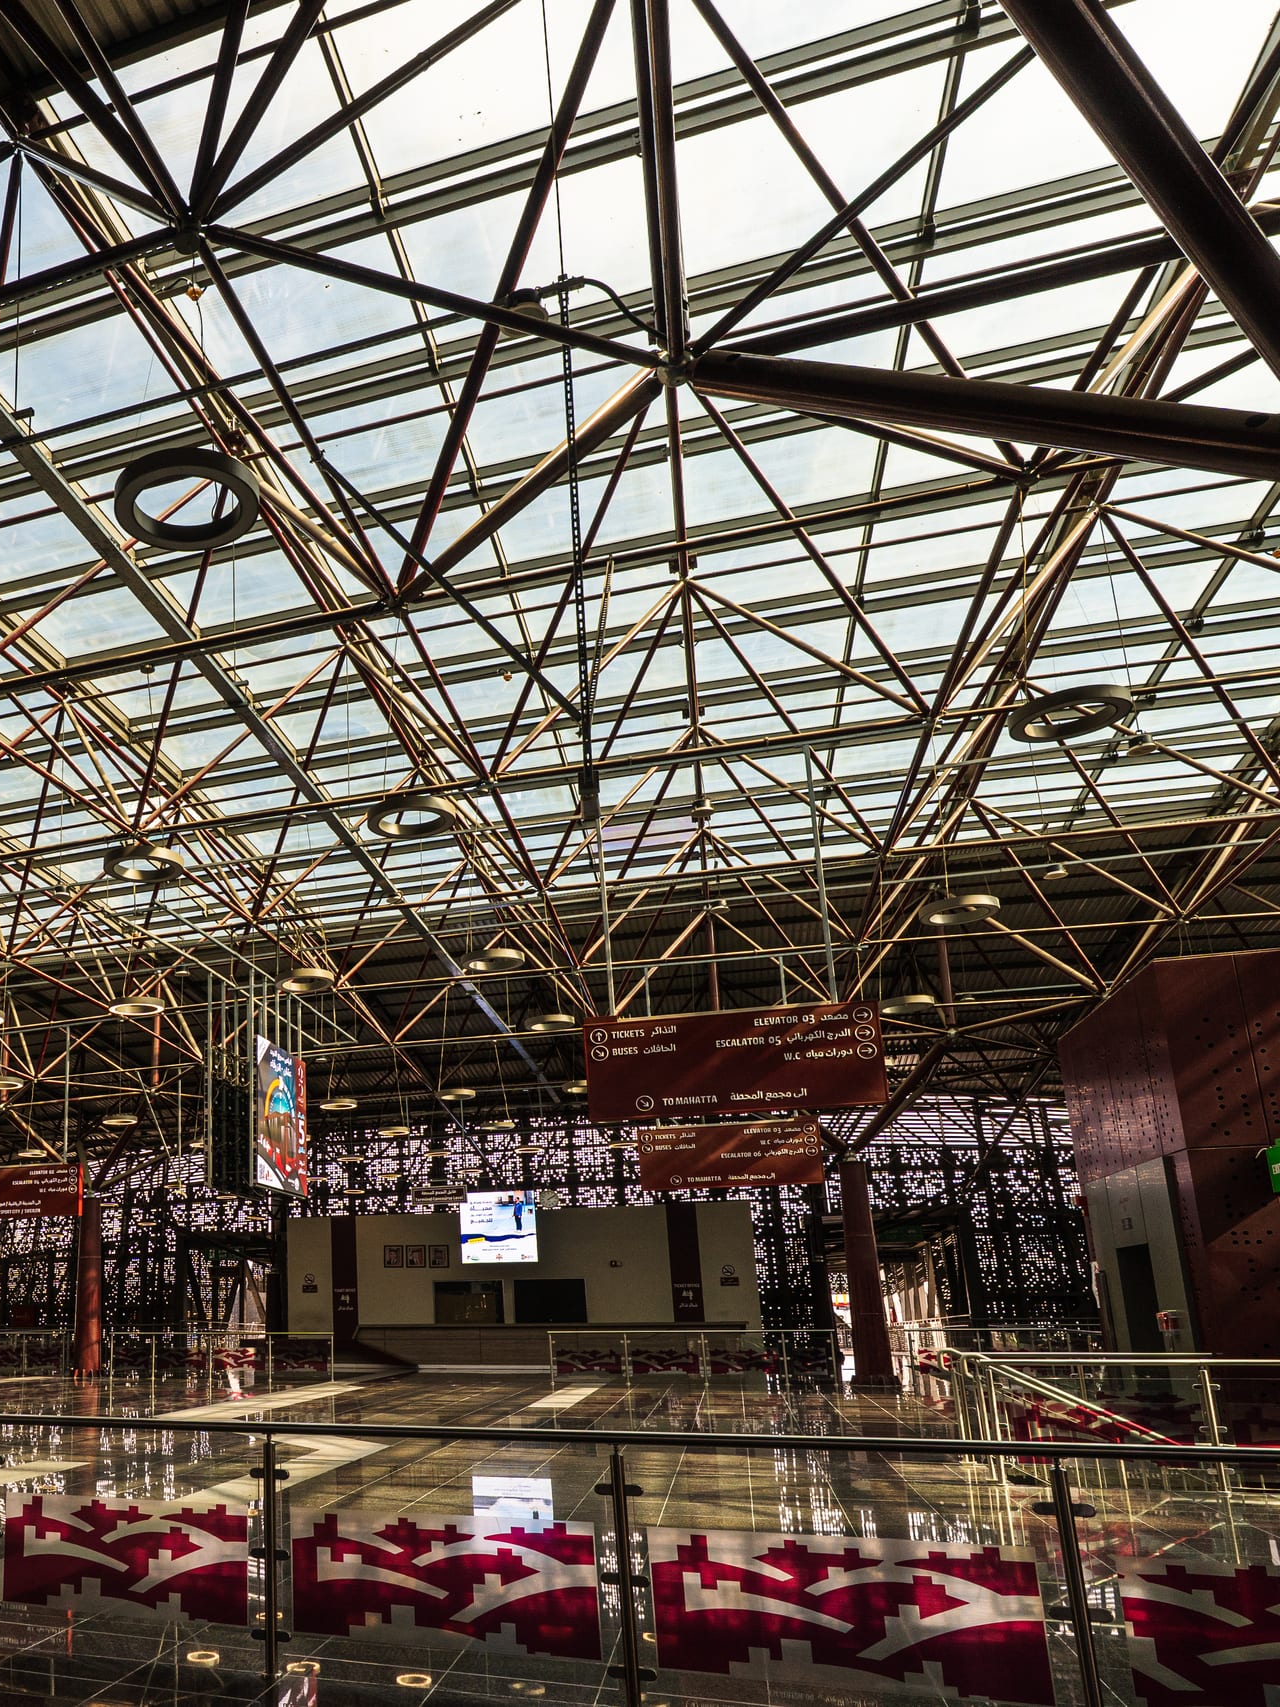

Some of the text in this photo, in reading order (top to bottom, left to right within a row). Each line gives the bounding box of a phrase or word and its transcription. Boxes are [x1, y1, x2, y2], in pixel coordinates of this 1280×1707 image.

[754, 1014, 815, 1027] ELEVATOR 03
[820, 1013, 849, 1021] مصعد
[611, 1029, 645, 1039] TICKETS
[650, 1025, 677, 1037] التذاكر
[786, 1028, 851, 1044] الدرج الكهربائي
[715, 1036, 782, 1048] ESCALATOR 05
[612, 1047, 639, 1056] BUSES
[643, 1043, 676, 1054] الحافلات
[805, 1048, 853, 1059] دورات مياه
[784, 1052, 801, 1061] W.C
[662, 1095, 718, 1106] TO MAHATTA
[730, 1091, 763, 1101] المحطة
[765, 1091, 792, 1101] مجمع
[298, 1120, 305, 1144] 5
